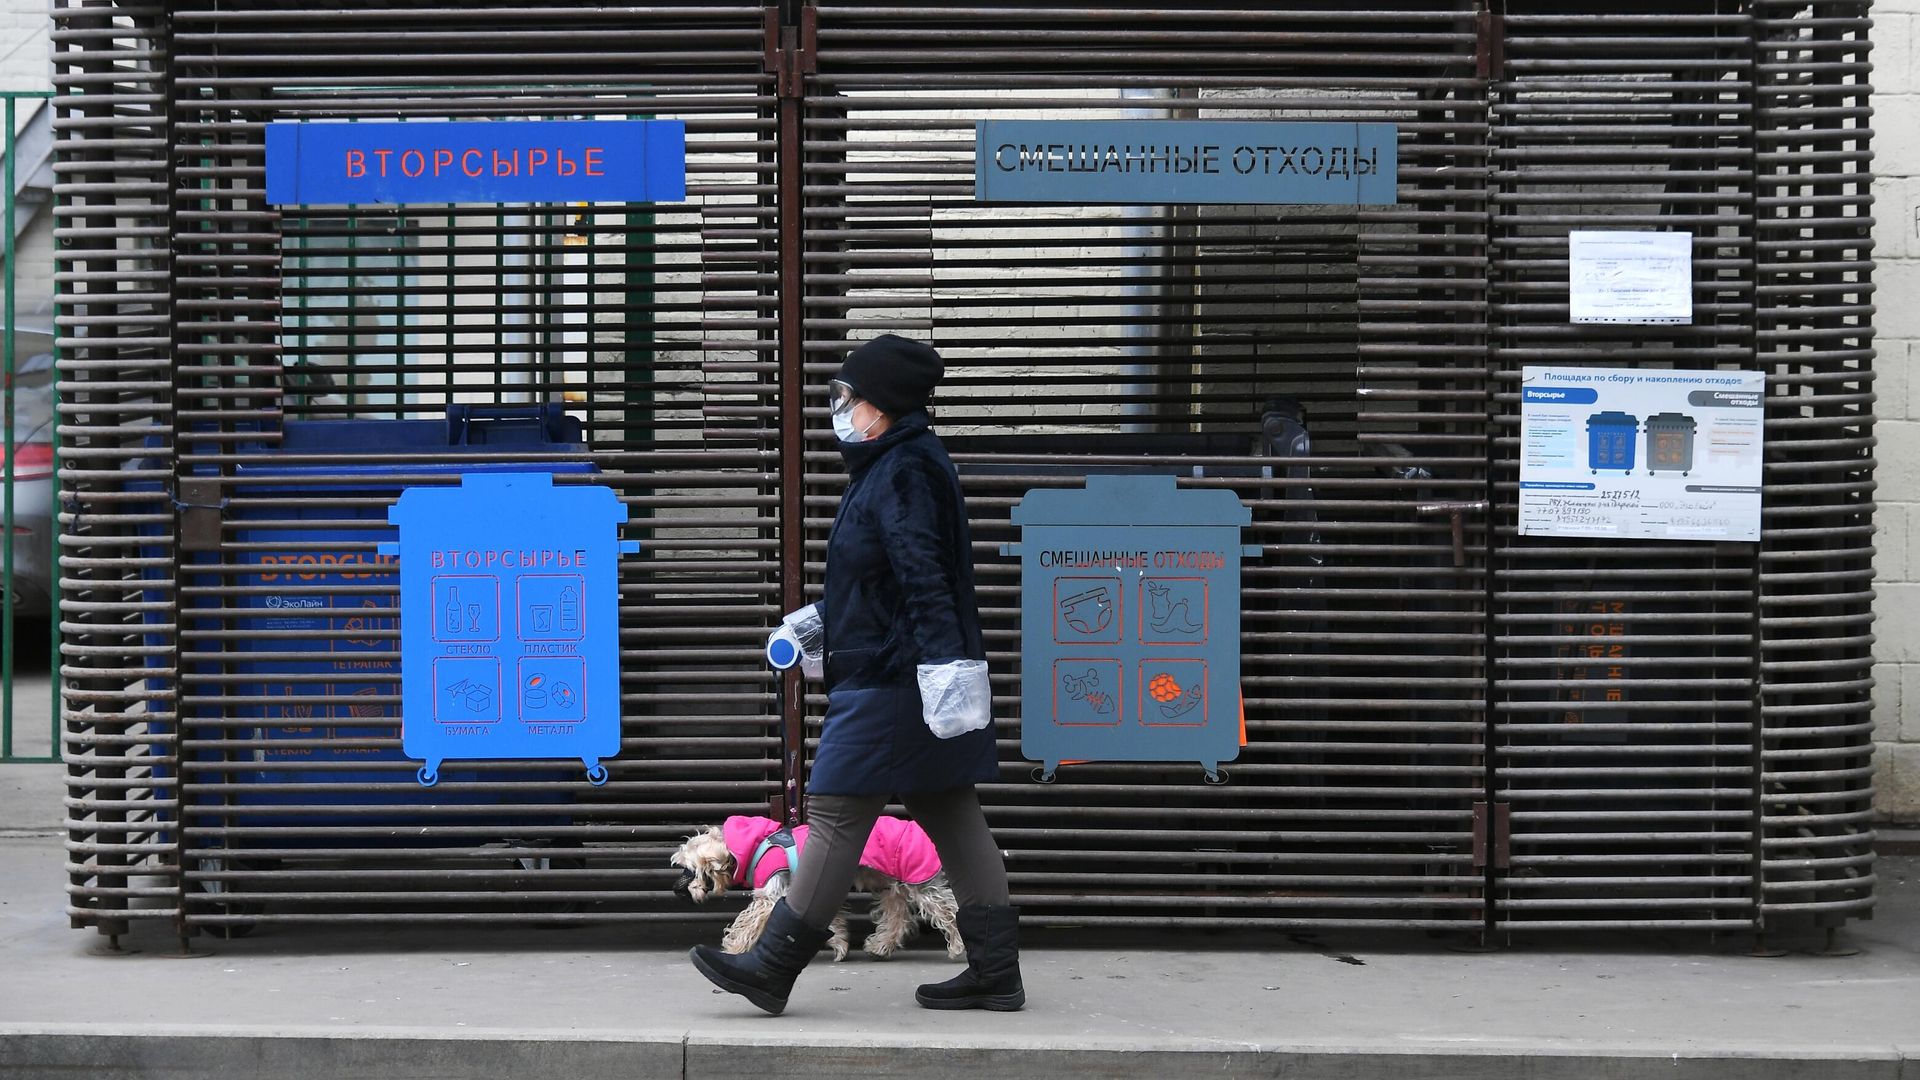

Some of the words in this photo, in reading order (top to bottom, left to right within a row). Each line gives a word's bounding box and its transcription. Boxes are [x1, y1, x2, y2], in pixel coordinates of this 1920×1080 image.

[346, 147, 605, 178] ВТОРСЫРЬЕ
[996, 143, 1220, 174] СМЕШАННЫЕ
[1232, 145, 1377, 180] ОТХОДЫ
[1544, 372, 1592, 382] Площадка
[1608, 374, 1634, 384] сбору
[1645, 376, 1703, 384] накоплению
[1527, 390, 1566, 399] Вторсырье
[1713, 392, 1759, 400] Смешанные
[431, 549, 587, 568] ВТОРСЫРЬЕ
[1039, 551, 1148, 568] СМЕШАННЫЕ
[1153, 551, 1225, 570] ОТХОДЫ
[282, 599, 324, 609] ЭкоЛайн
[445, 644, 491, 655] СТЕКЛО
[524, 643, 577, 654] ПЛАСТИК
[445, 726, 490, 736] БУМАГА
[528, 725, 574, 735] МЕТАЛЛ
